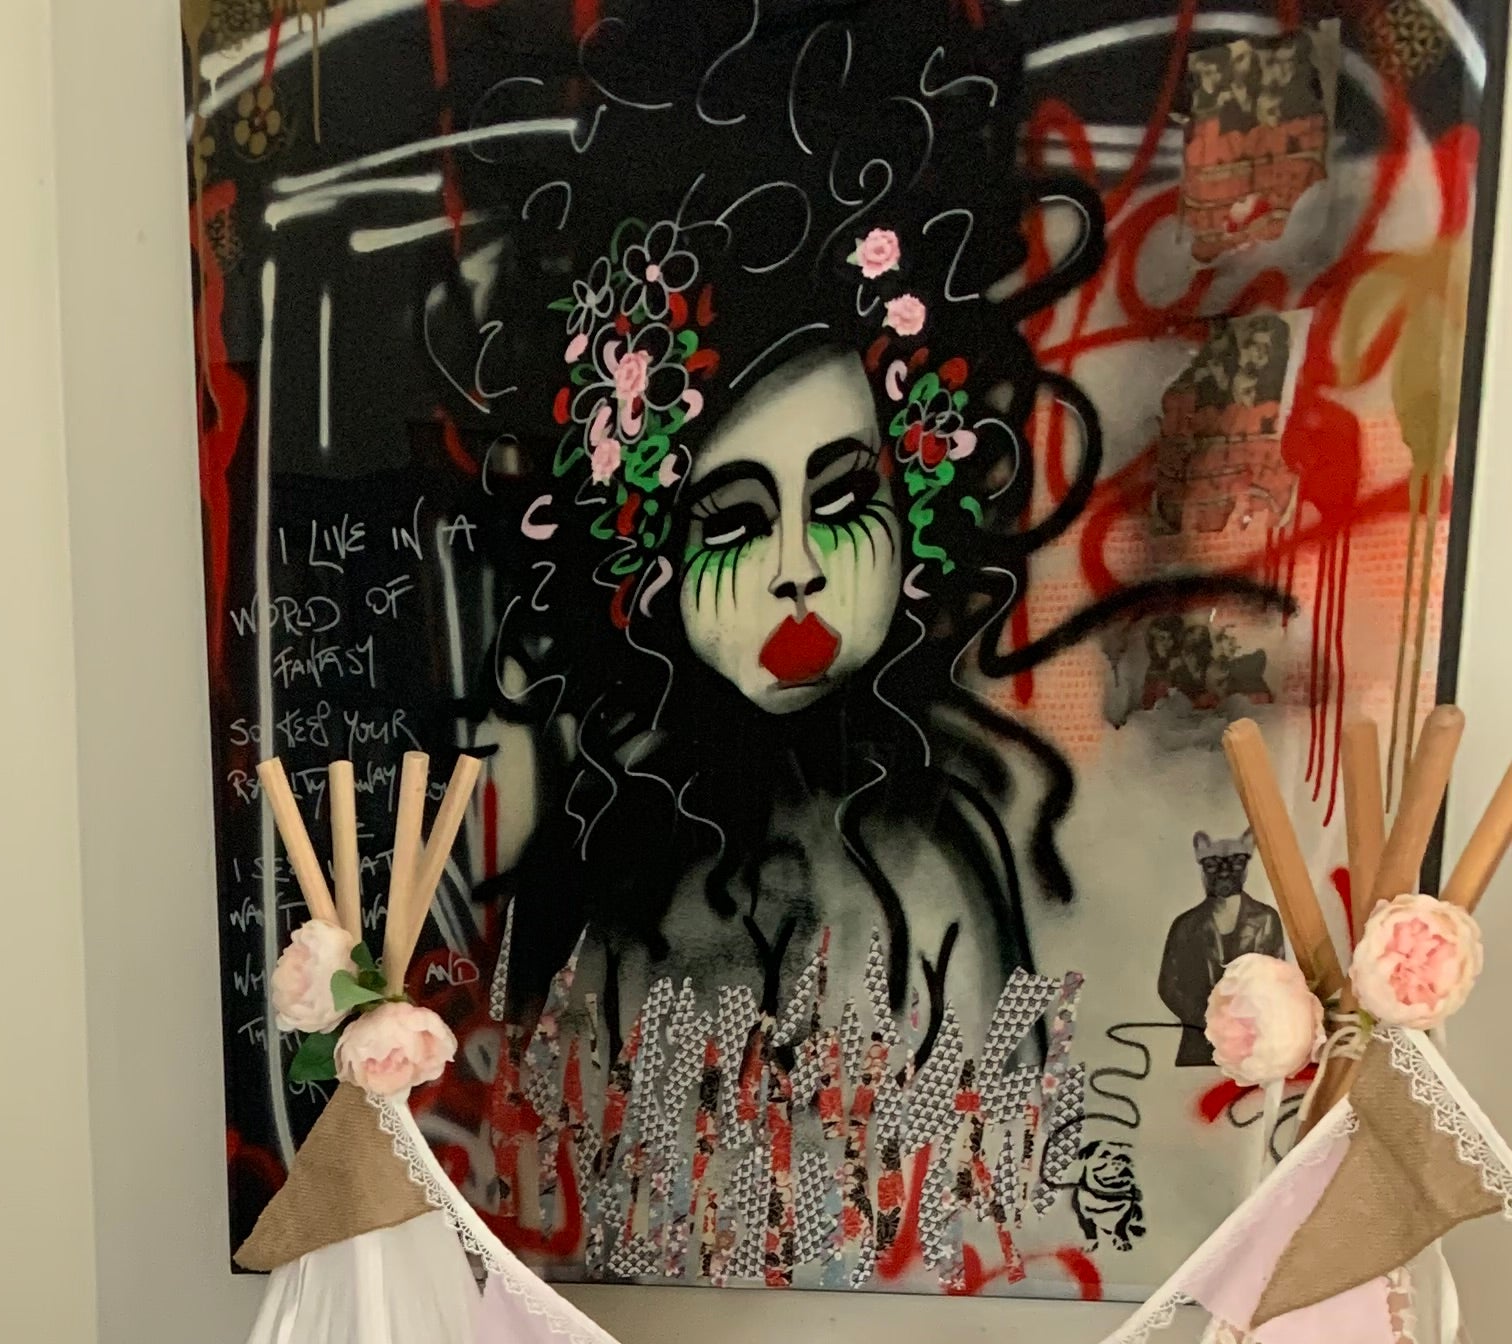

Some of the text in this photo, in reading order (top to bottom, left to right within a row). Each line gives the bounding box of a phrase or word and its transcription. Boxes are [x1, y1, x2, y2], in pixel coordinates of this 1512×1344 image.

[279, 496, 478, 574] I LIVE IN A
[230, 575, 415, 637] WORLD OF
[273, 636, 376, 689] FANTASY
[230, 718, 262, 746] SO
[344, 708, 423, 762] YOUR
[424, 953, 480, 987] AND
